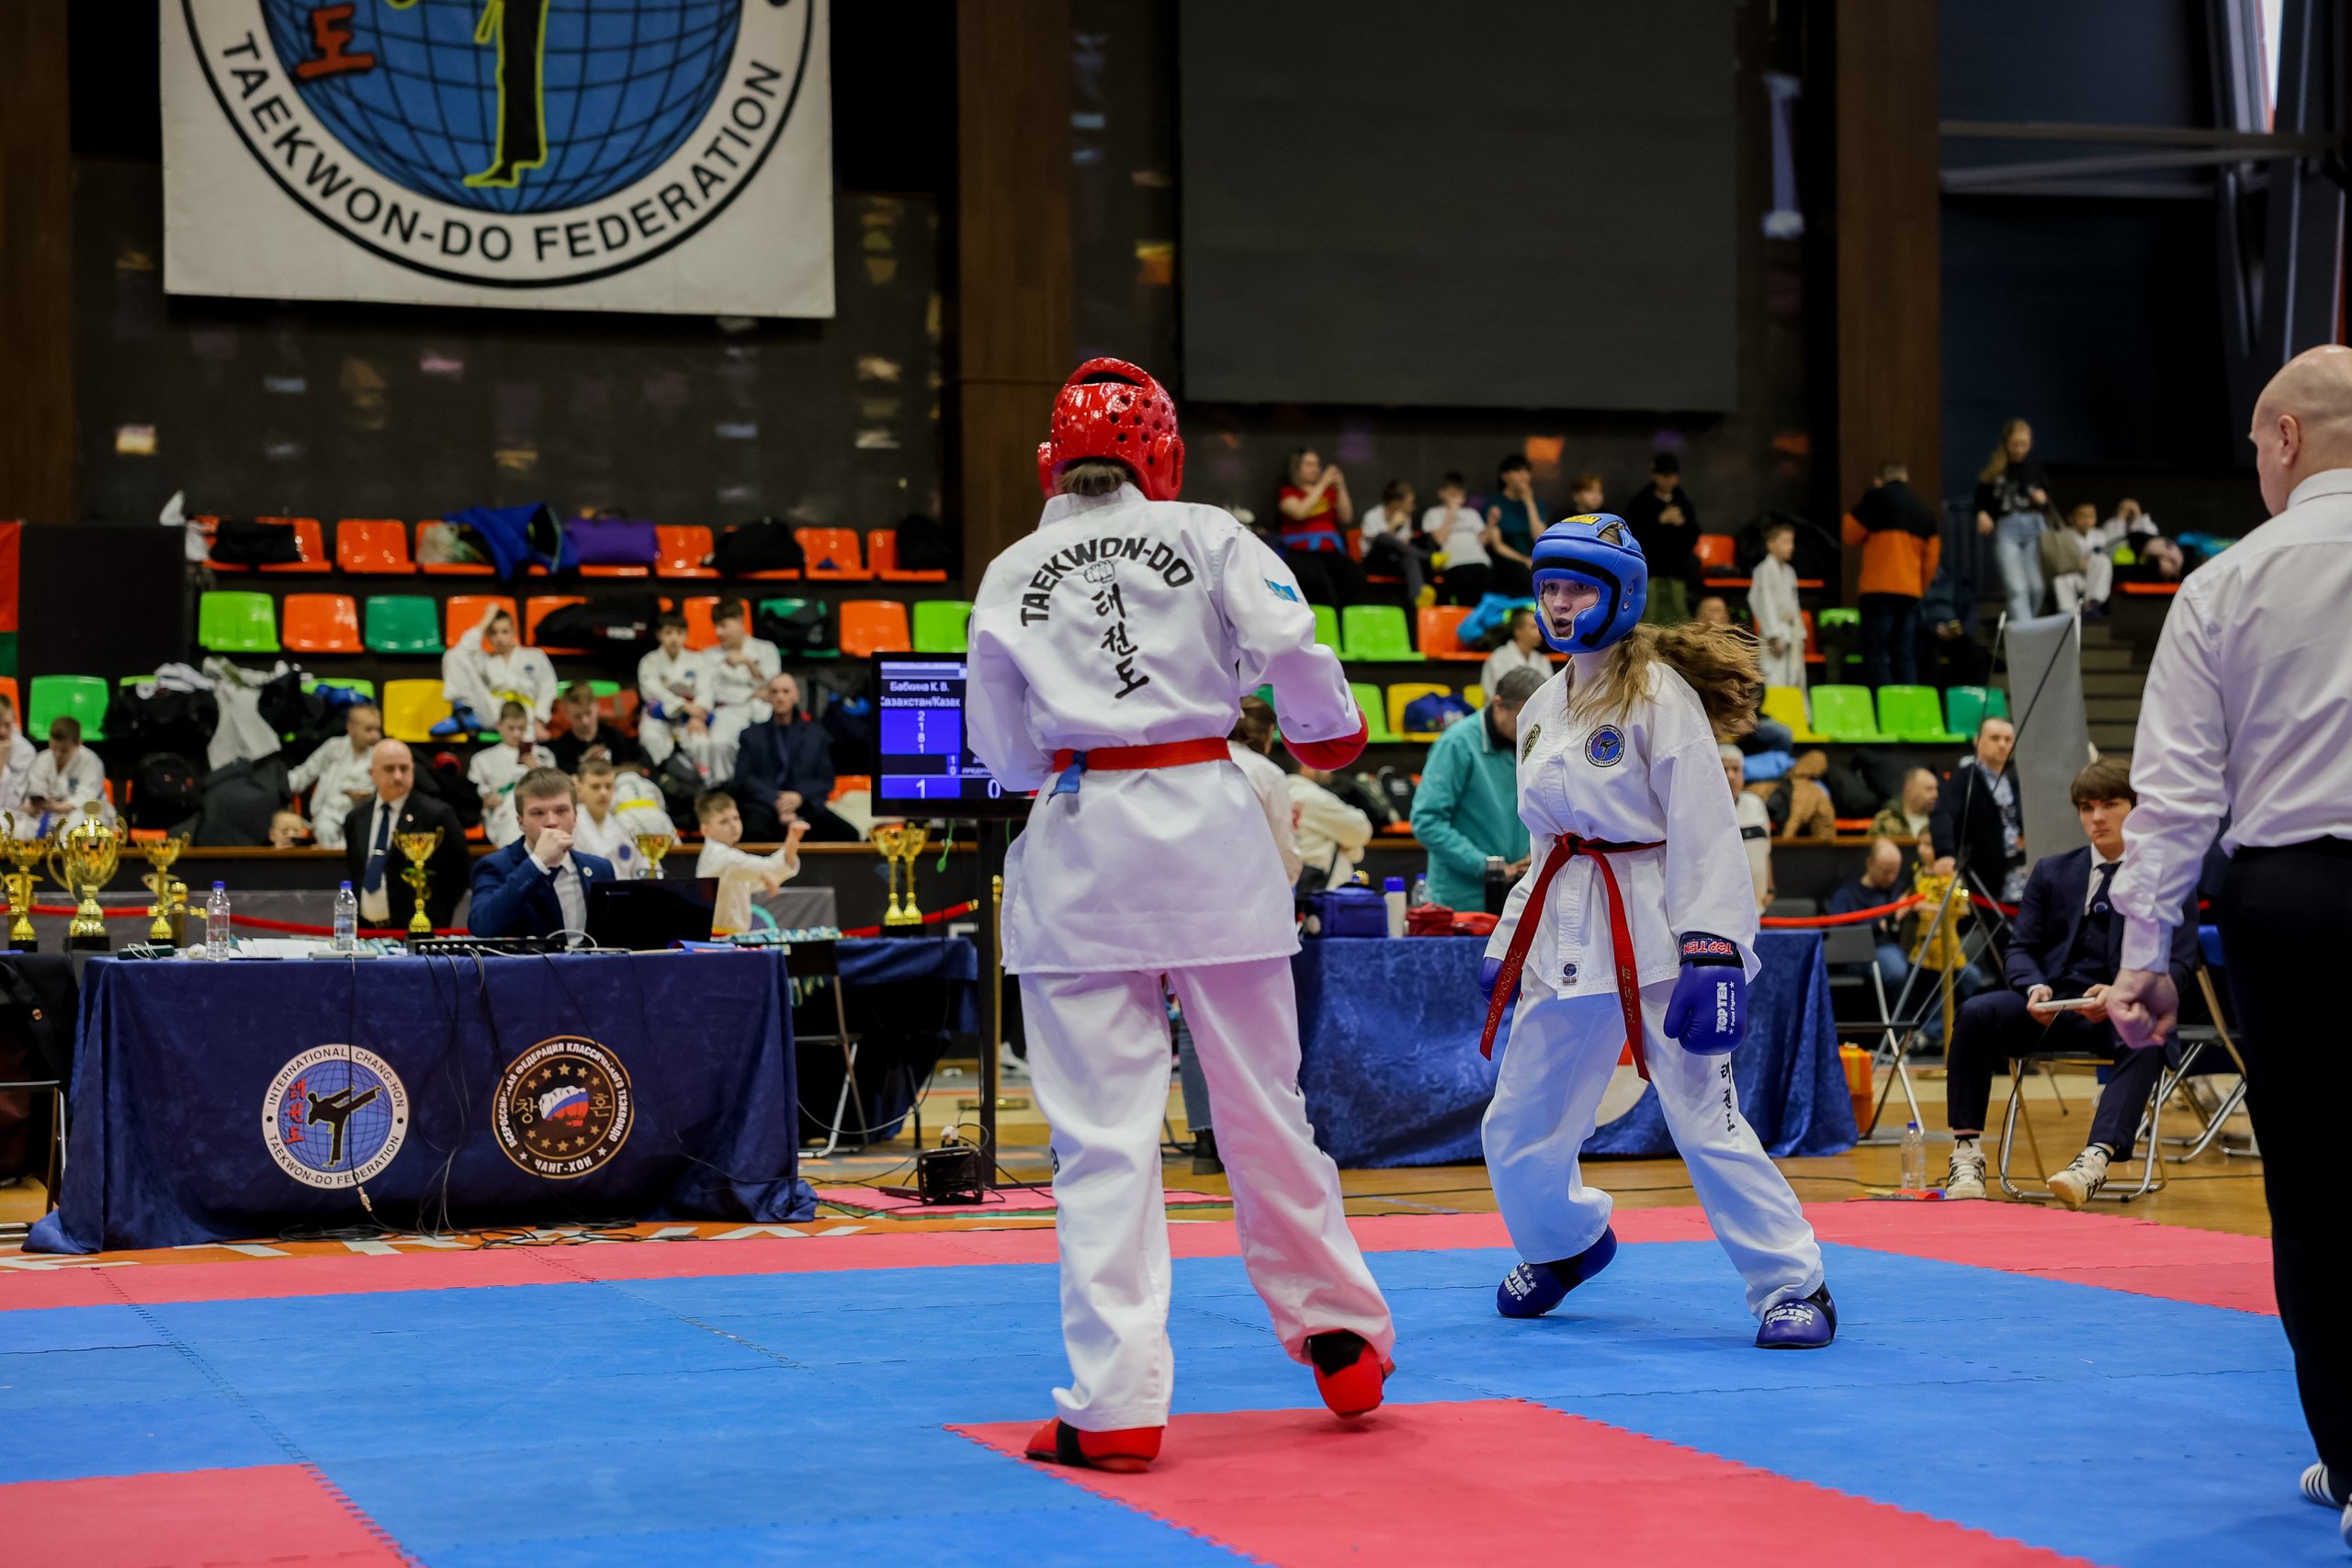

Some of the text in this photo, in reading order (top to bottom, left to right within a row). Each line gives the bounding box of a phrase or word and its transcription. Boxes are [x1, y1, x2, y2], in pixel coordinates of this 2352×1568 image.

[222, 31, 784, 263] TAEKWON-DO FEDERATION
[1021, 536, 1194, 627] TAEKWON-DO
[917, 709, 925, 722] 2
[918, 721, 924, 732] 1
[918, 742, 924, 754] 1
[949, 765, 956, 776] 0
[950, 755, 956, 765] 1
[916, 778, 926, 799] 1
[987, 778, 1001, 799] 0
[1683, 939, 1734, 955] TOP TEN
[1715, 981, 1728, 1033] TOP TEN
[268, 1047, 405, 1108] INTERNATIONAL CHANG-HON
[515, 1042, 564, 1075] ФЕДЕРАЦИЯ
[608, 1089, 628, 1143] ТХЭКВОНДО
[285, 1077, 307, 1145] 태권도
[515, 1092, 613, 1124] 창 혼
[268, 1134, 401, 1185] TAEKWON-DO FEDERATION
[534, 1156, 593, 1174] ЧАНГ-ХОН
[1511, 1273, 1532, 1297] TEN
[1766, 1308, 1814, 1322] TOP TEN
[1770, 1314, 1806, 1324] FIGHT
